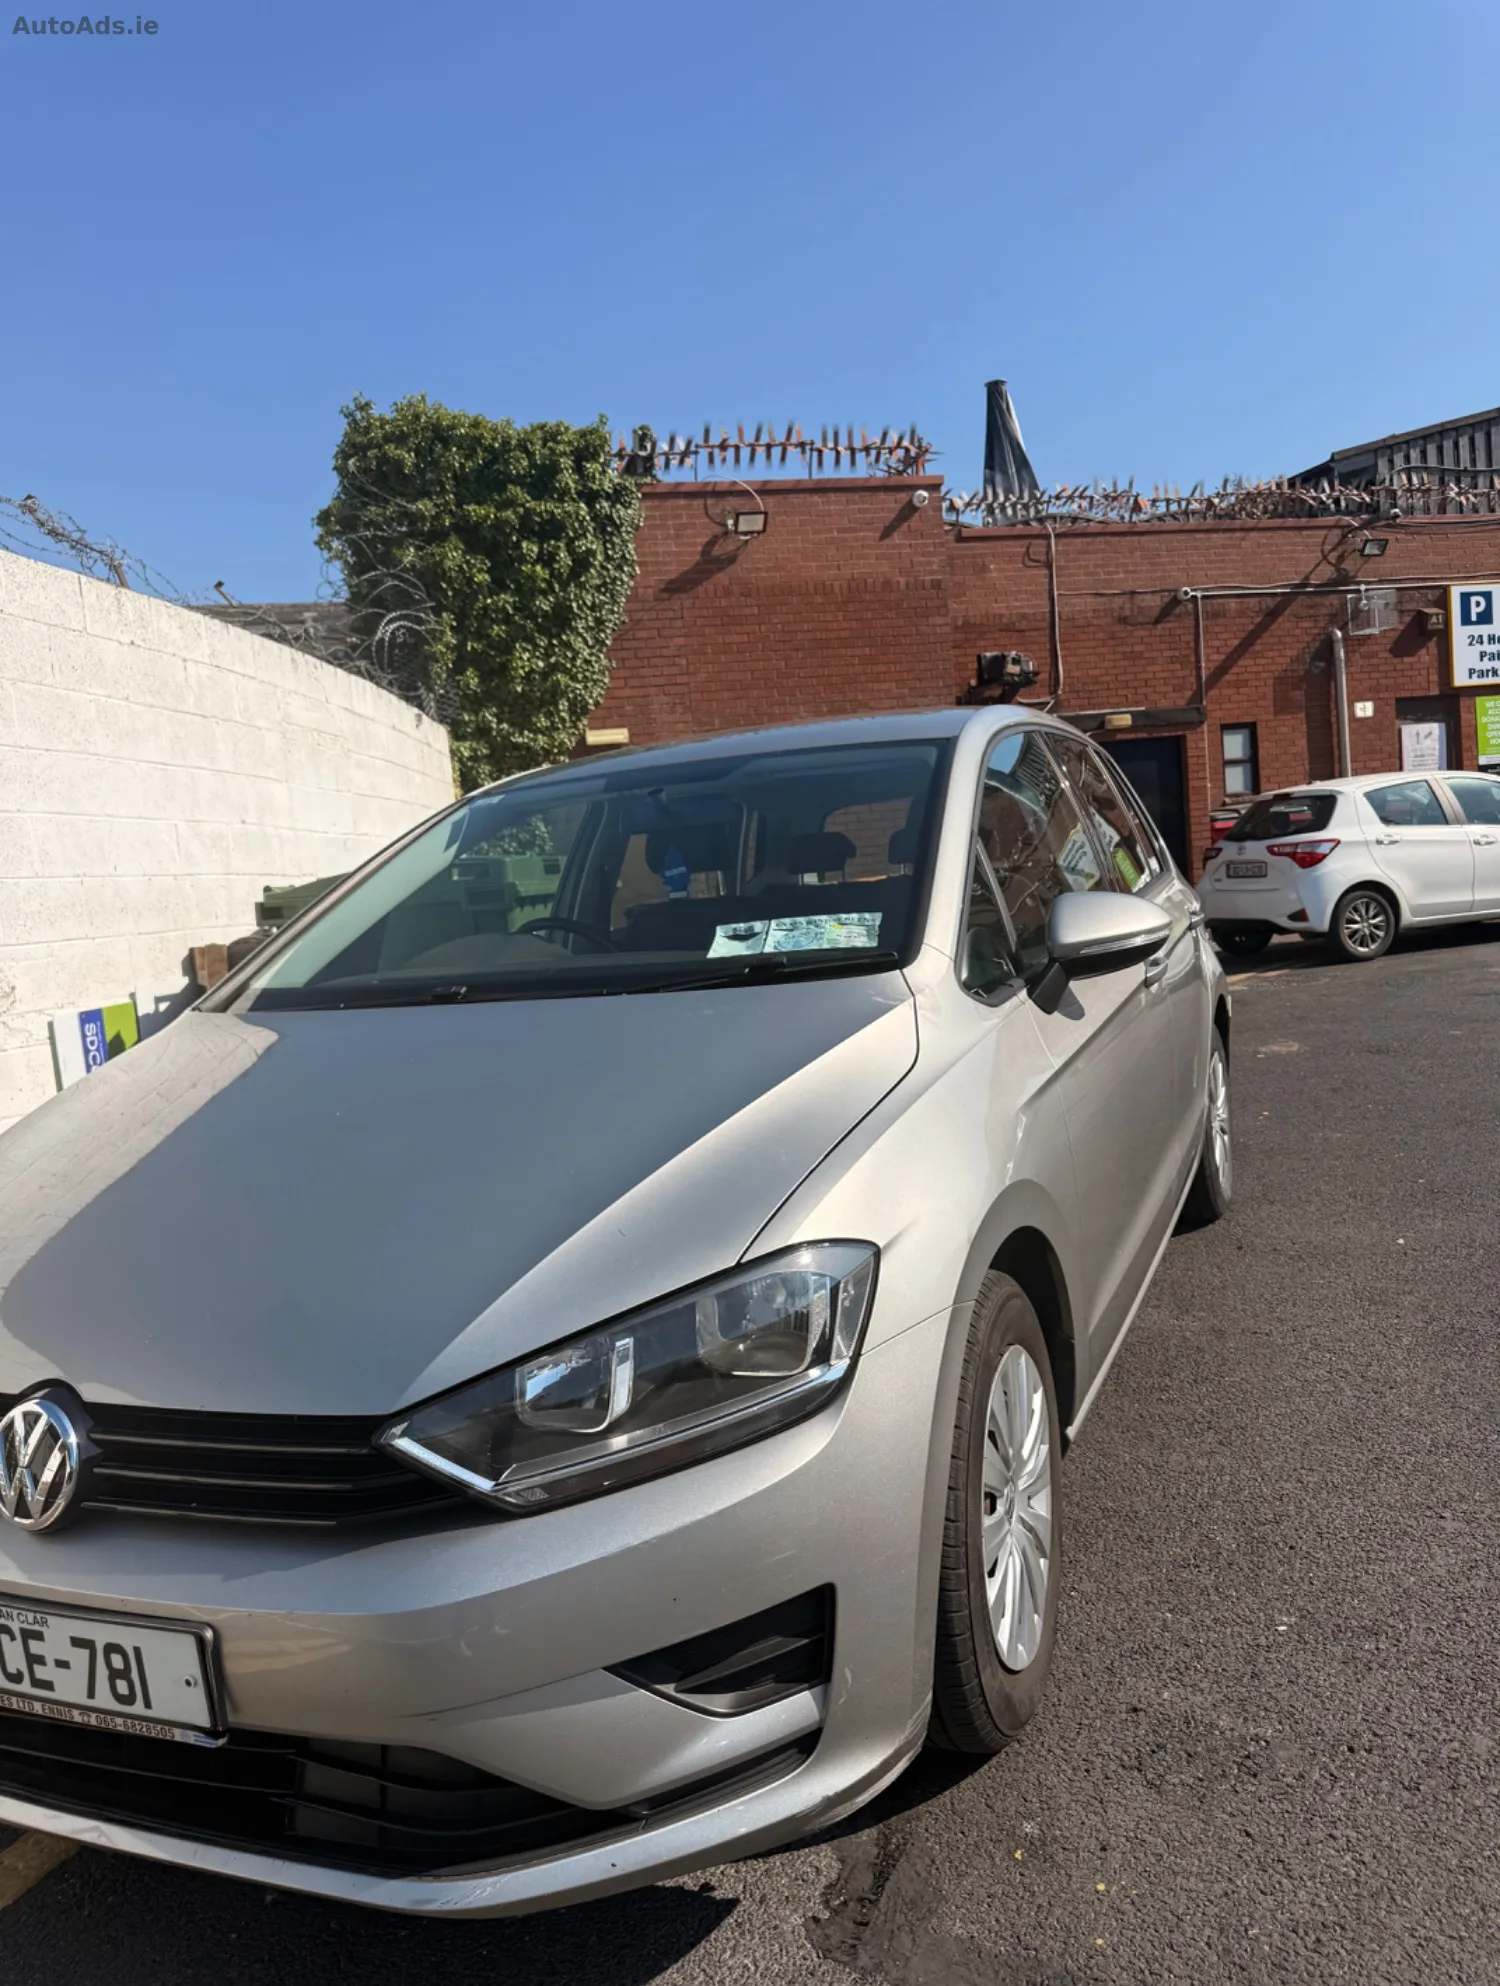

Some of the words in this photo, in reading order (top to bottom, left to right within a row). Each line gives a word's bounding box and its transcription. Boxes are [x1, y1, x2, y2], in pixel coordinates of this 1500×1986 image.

[1470, 595, 1486, 622] P
[1467, 634, 1484, 646] 24
[84, 1022, 100, 1071] SDC
[16, 1697, 39, 1712] LTD.
[41, 1703, 75, 1720] ENNIS
[95, 1714, 176, 1740] 065-6828505
